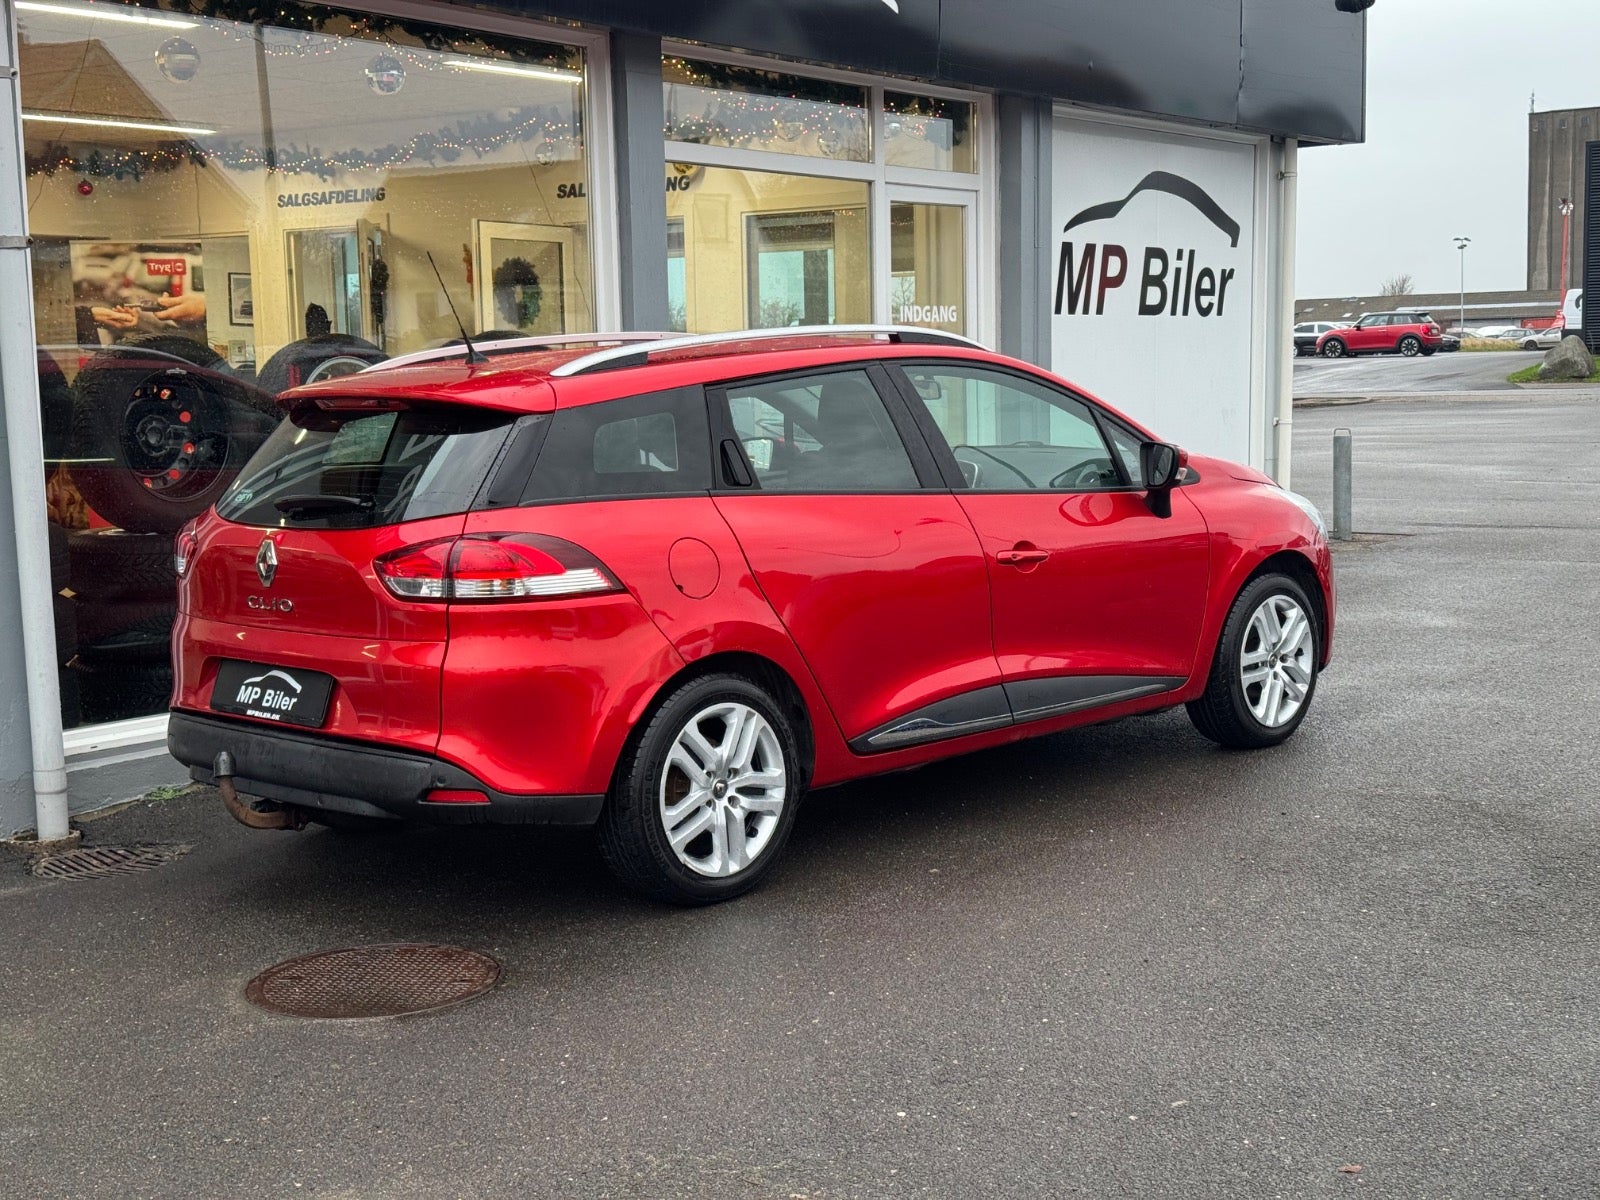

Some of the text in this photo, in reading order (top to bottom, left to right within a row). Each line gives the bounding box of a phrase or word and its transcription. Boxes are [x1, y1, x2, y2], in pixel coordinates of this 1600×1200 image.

[277, 187, 386, 208] SALGSAFDELING
[148, 262, 171, 273] Tryg
[1054, 241, 1235, 318] MP Biler
[899, 304, 958, 323] INDGANG
[247, 595, 294, 612] CLIO
[236, 685, 298, 711] MP Biler
